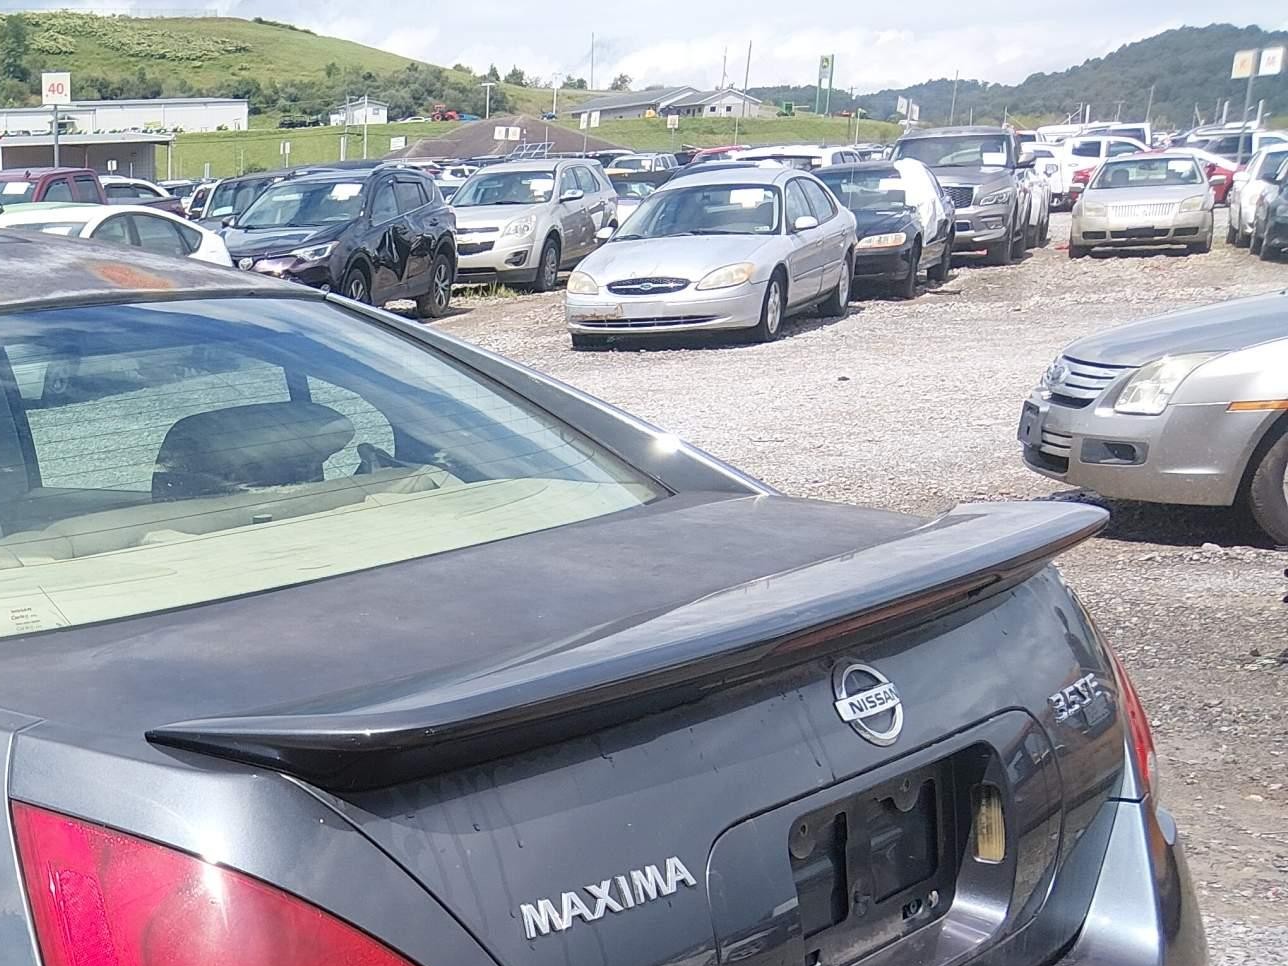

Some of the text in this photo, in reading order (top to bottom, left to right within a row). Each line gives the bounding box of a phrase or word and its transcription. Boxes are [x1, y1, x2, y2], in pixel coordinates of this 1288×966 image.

[48, 82, 64, 95] 40
[848, 687, 896, 714] NISSAN
[520, 856, 697, 940] MAXIMA
